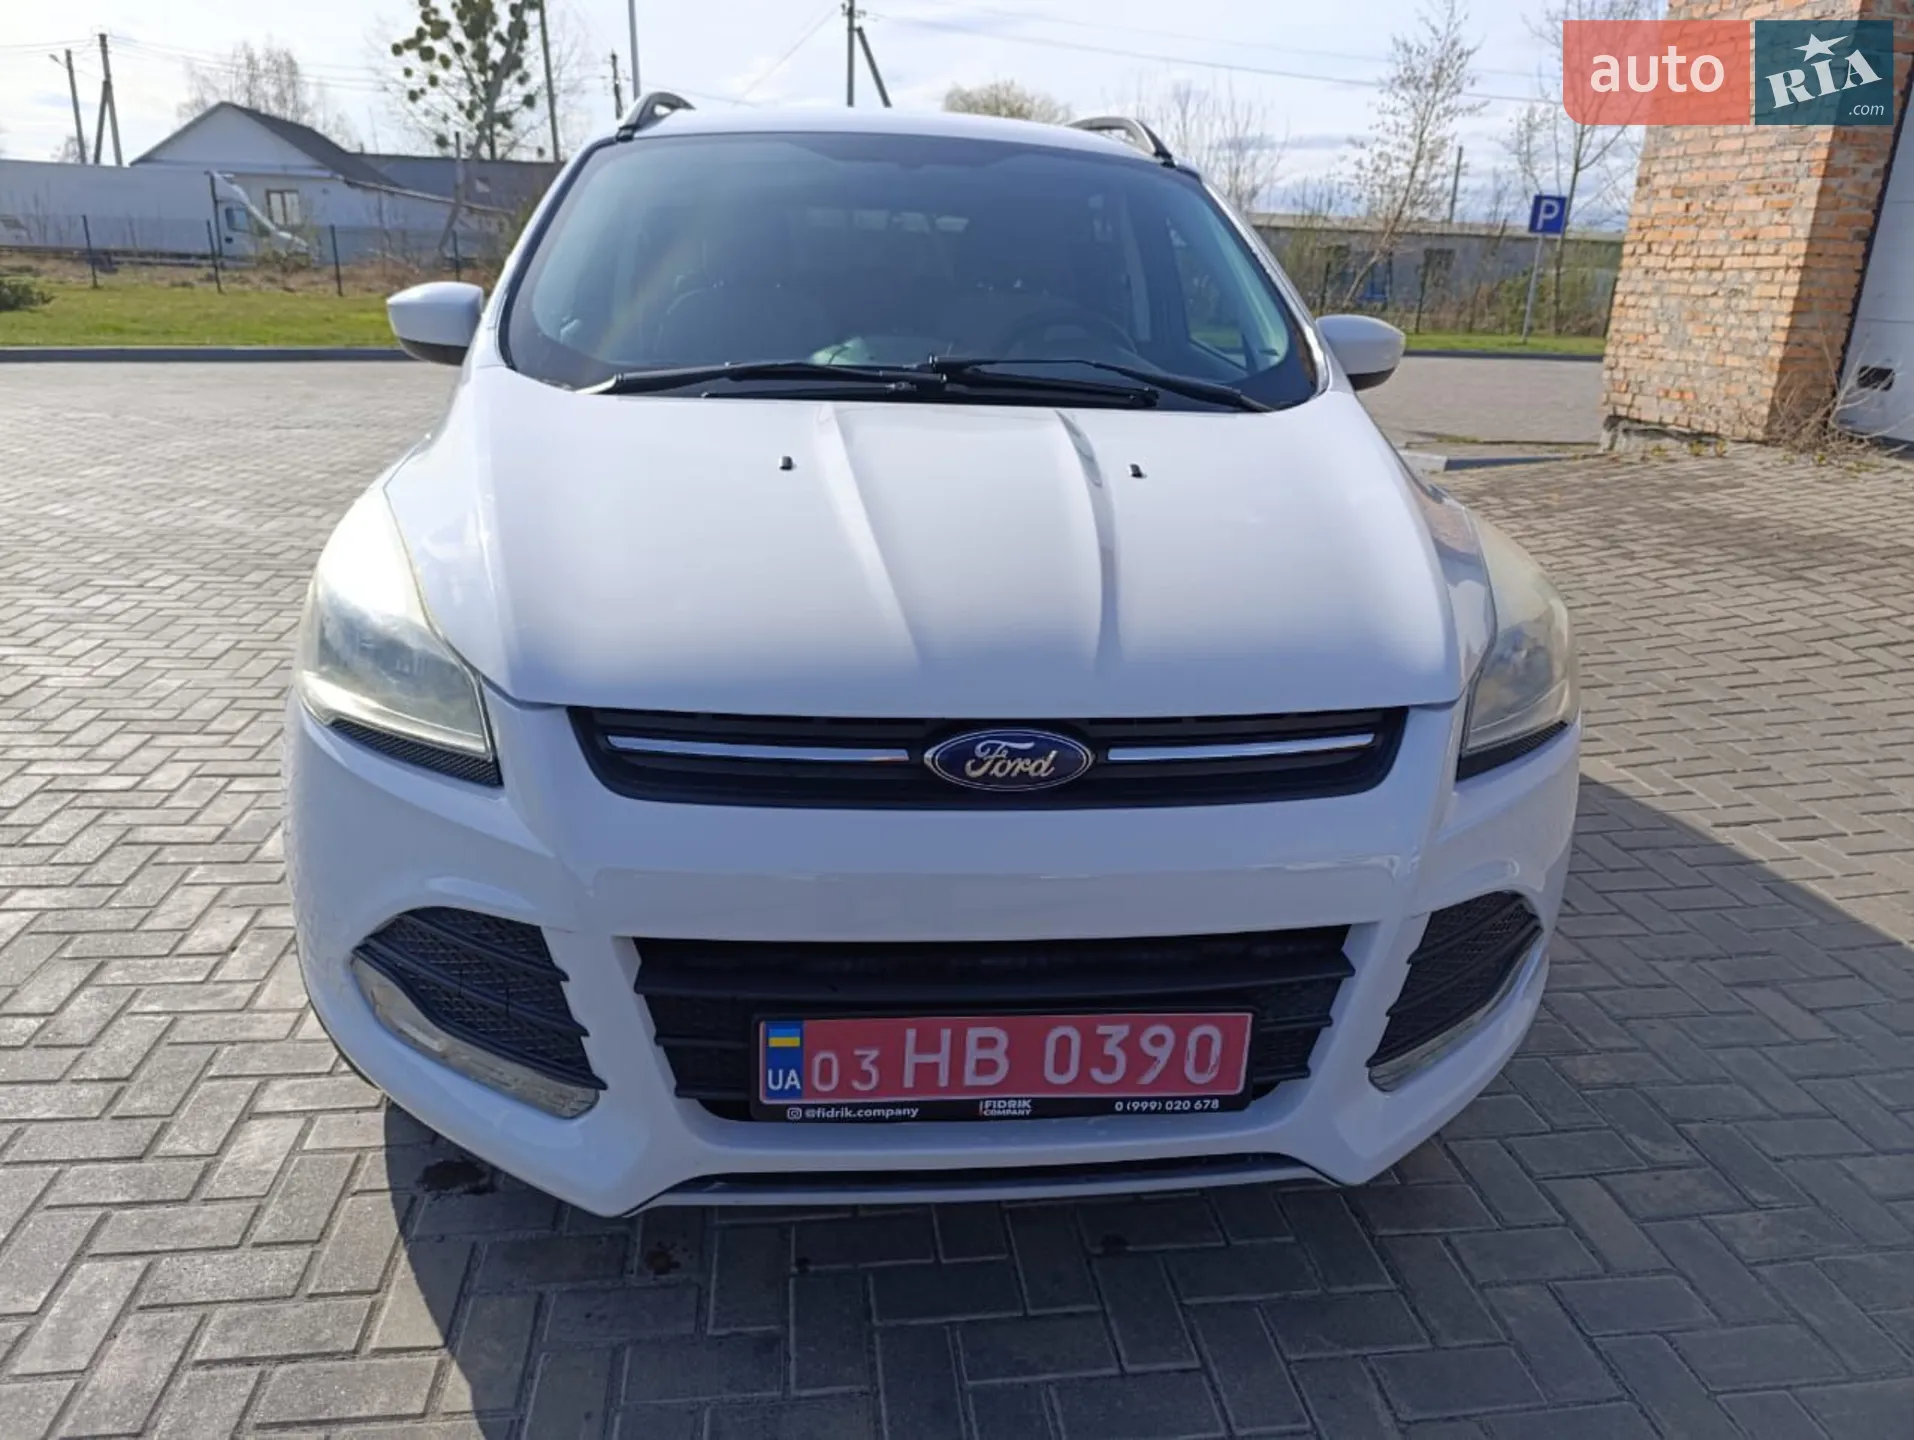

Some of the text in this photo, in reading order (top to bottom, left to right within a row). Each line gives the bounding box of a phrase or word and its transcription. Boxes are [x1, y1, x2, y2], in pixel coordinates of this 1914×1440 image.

[1536, 199, 1560, 230] P
[965, 740, 1058, 778] Ford
[1044, 1024, 1223, 1086] 0390
[767, 1068, 801, 1090] UA
[805, 1106, 919, 1120] @fidrik.company
